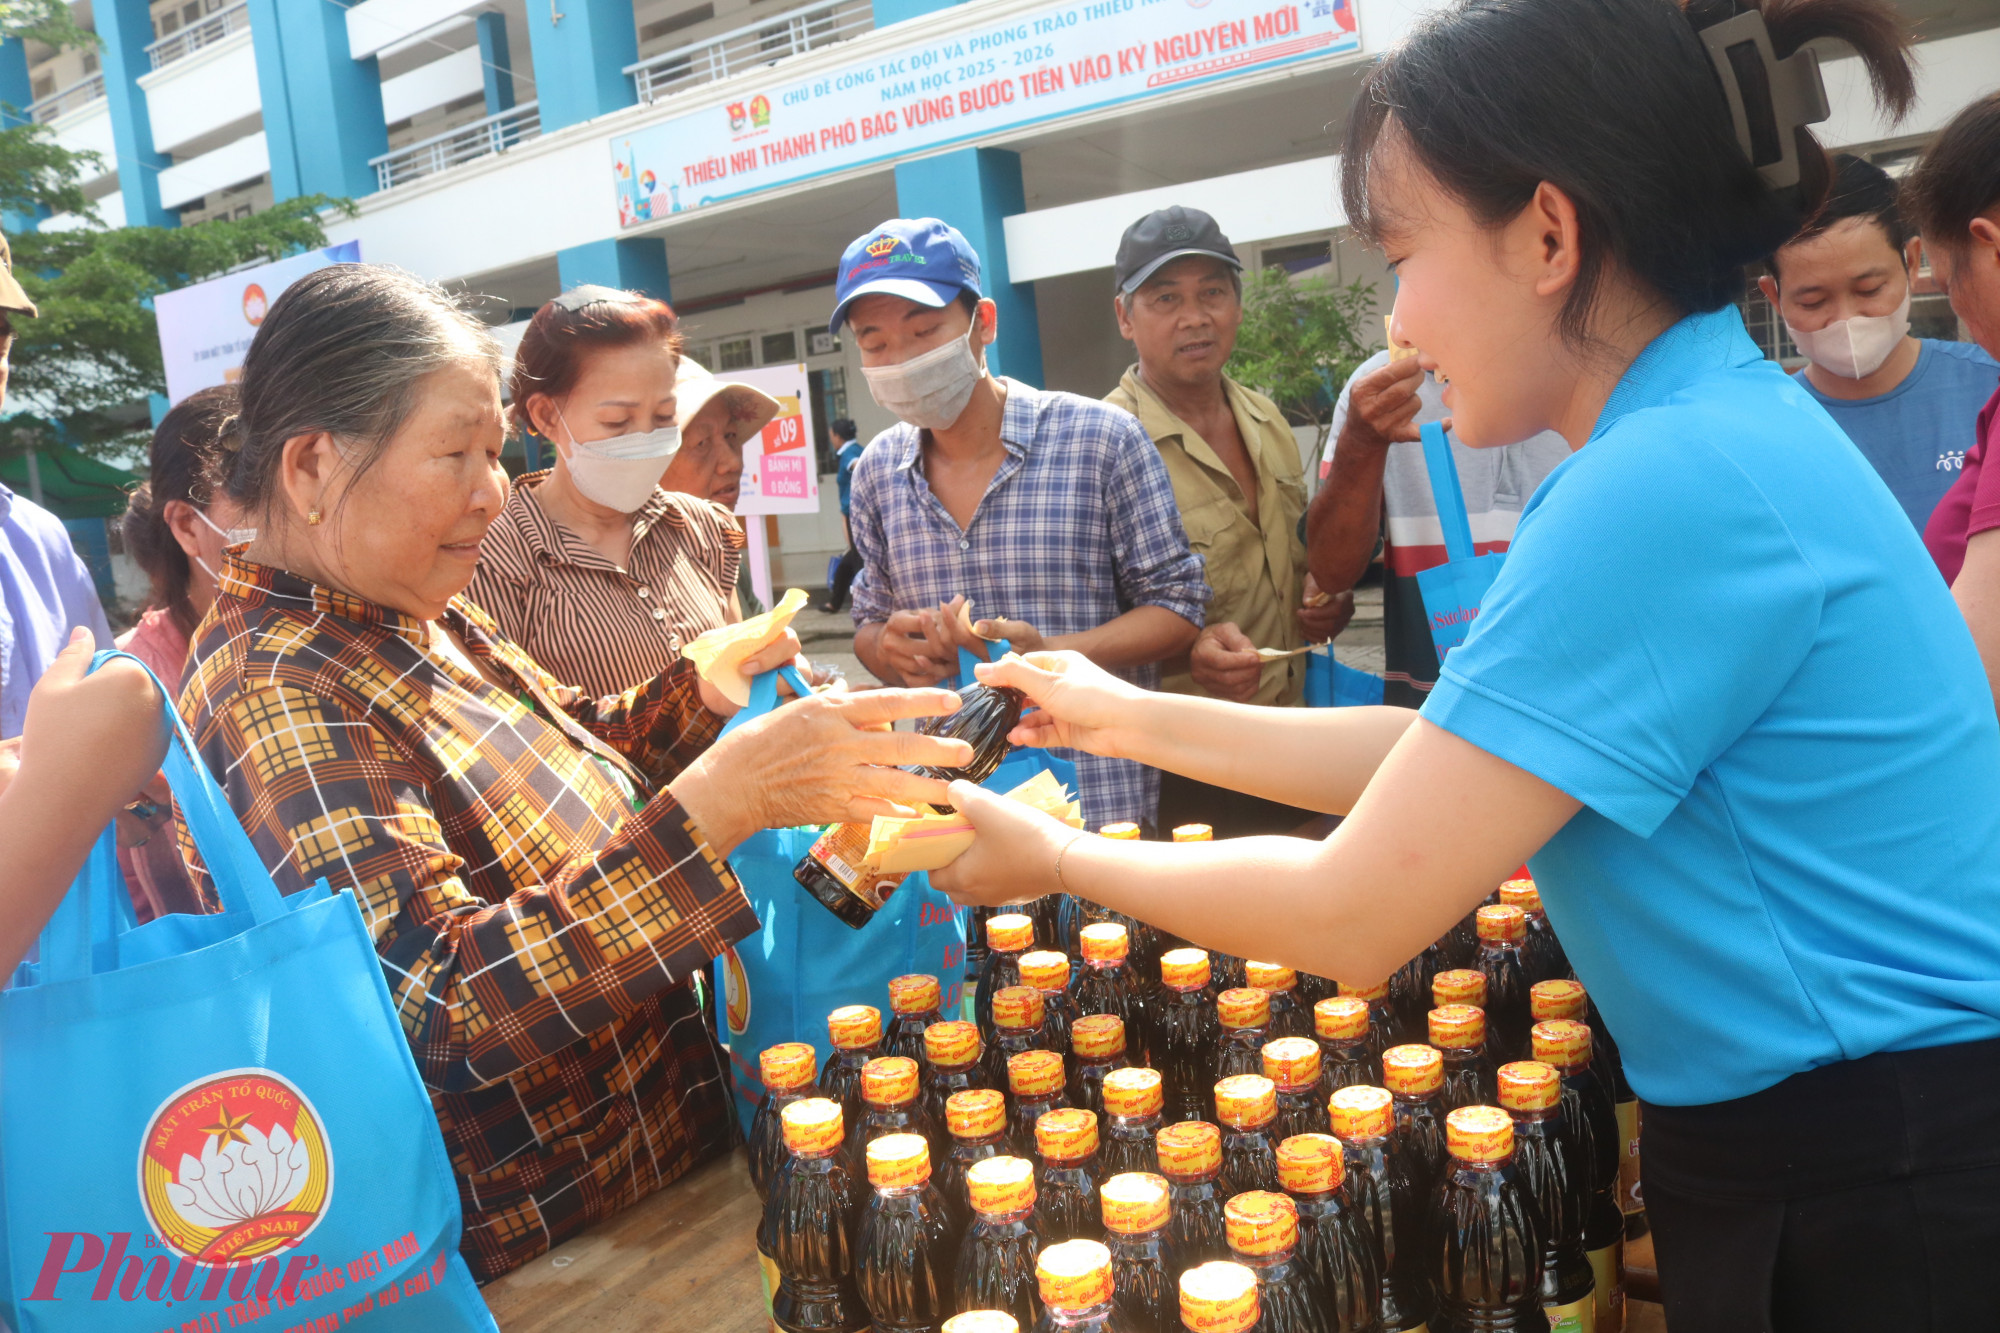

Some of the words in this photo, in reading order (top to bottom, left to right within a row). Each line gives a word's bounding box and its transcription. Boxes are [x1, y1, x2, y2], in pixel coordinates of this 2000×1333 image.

[836, 68, 875, 91] CÔNG
[880, 58, 906, 79] TÁC
[910, 49, 938, 71] ĐỘI
[942, 42, 964, 60] VÀ
[969, 25, 1028, 54] PHONG
[1033, 11, 1077, 36] TRÀO
[921, 71, 952, 91] HỌC
[957, 58, 996, 82] 2025
[1014, 43, 1055, 66] 2026
[730, 147, 758, 175] NHI
[761, 132, 817, 167] THÀNH
[902, 97, 955, 129] VỮNG
[1019, 65, 1065, 99] TIẾN
[1069, 55, 1113, 86] VÀO
[1154, 20, 1248, 66] NGUYÊN
[1253, 4, 1301, 41] MỚI
[780, 418, 797, 443] 09
[1036, 971, 1062, 983] Cholimex
[901, 993, 926, 1005] Cholimex
[1356, 986, 1379, 998] Cholimex
[1239, 1010, 1264, 1026] Cholimex
[1325, 1022, 1353, 1034] Cholimex
[1439, 1031, 1468, 1041] Cholimex
[937, 1038, 963, 1050] Cholimex
[1086, 1038, 1110, 1050] Cholimex
[1536, 1048, 1565, 1056] Cholimex
[1017, 1075, 1047, 1086] Cholimex
[1294, 1066, 1317, 1082] Cholimex
[1399, 1076, 1425, 1087] Cholimex
[868, 1078, 898, 1089] Cholimex
[1124, 1094, 1150, 1109] Cholimex
[156, 1115, 179, 1150] MẶT
[178, 1089, 224, 1118] TRẬN
[228, 1080, 251, 1098] TỔ
[256, 1086, 292, 1110] QUỐC
[1248, 1105, 1274, 1125] Cholimex
[1349, 1109, 1379, 1124] Cholimex
[790, 1138, 818, 1148] Cholimex
[1064, 1127, 1093, 1147] Cholimex
[1172, 1150, 1207, 1163] Cholimex
[881, 1168, 913, 1183] Cholimex
[1288, 1176, 1324, 1189] Cholimex
[980, 1193, 1015, 1208] Cholimex
[1137, 1208, 1167, 1228] Cholimex
[215, 1227, 254, 1258] VIỆT
[260, 1220, 299, 1235] NAM
[1238, 1232, 1276, 1247] Cholimex
[300, 1263, 346, 1303] QUỐC
[347, 1250, 383, 1283] VIỆT
[381, 1231, 421, 1268] NAM
[1055, 1272, 1092, 1290] Cholimex
[1196, 1314, 1235, 1328] Cholimex
